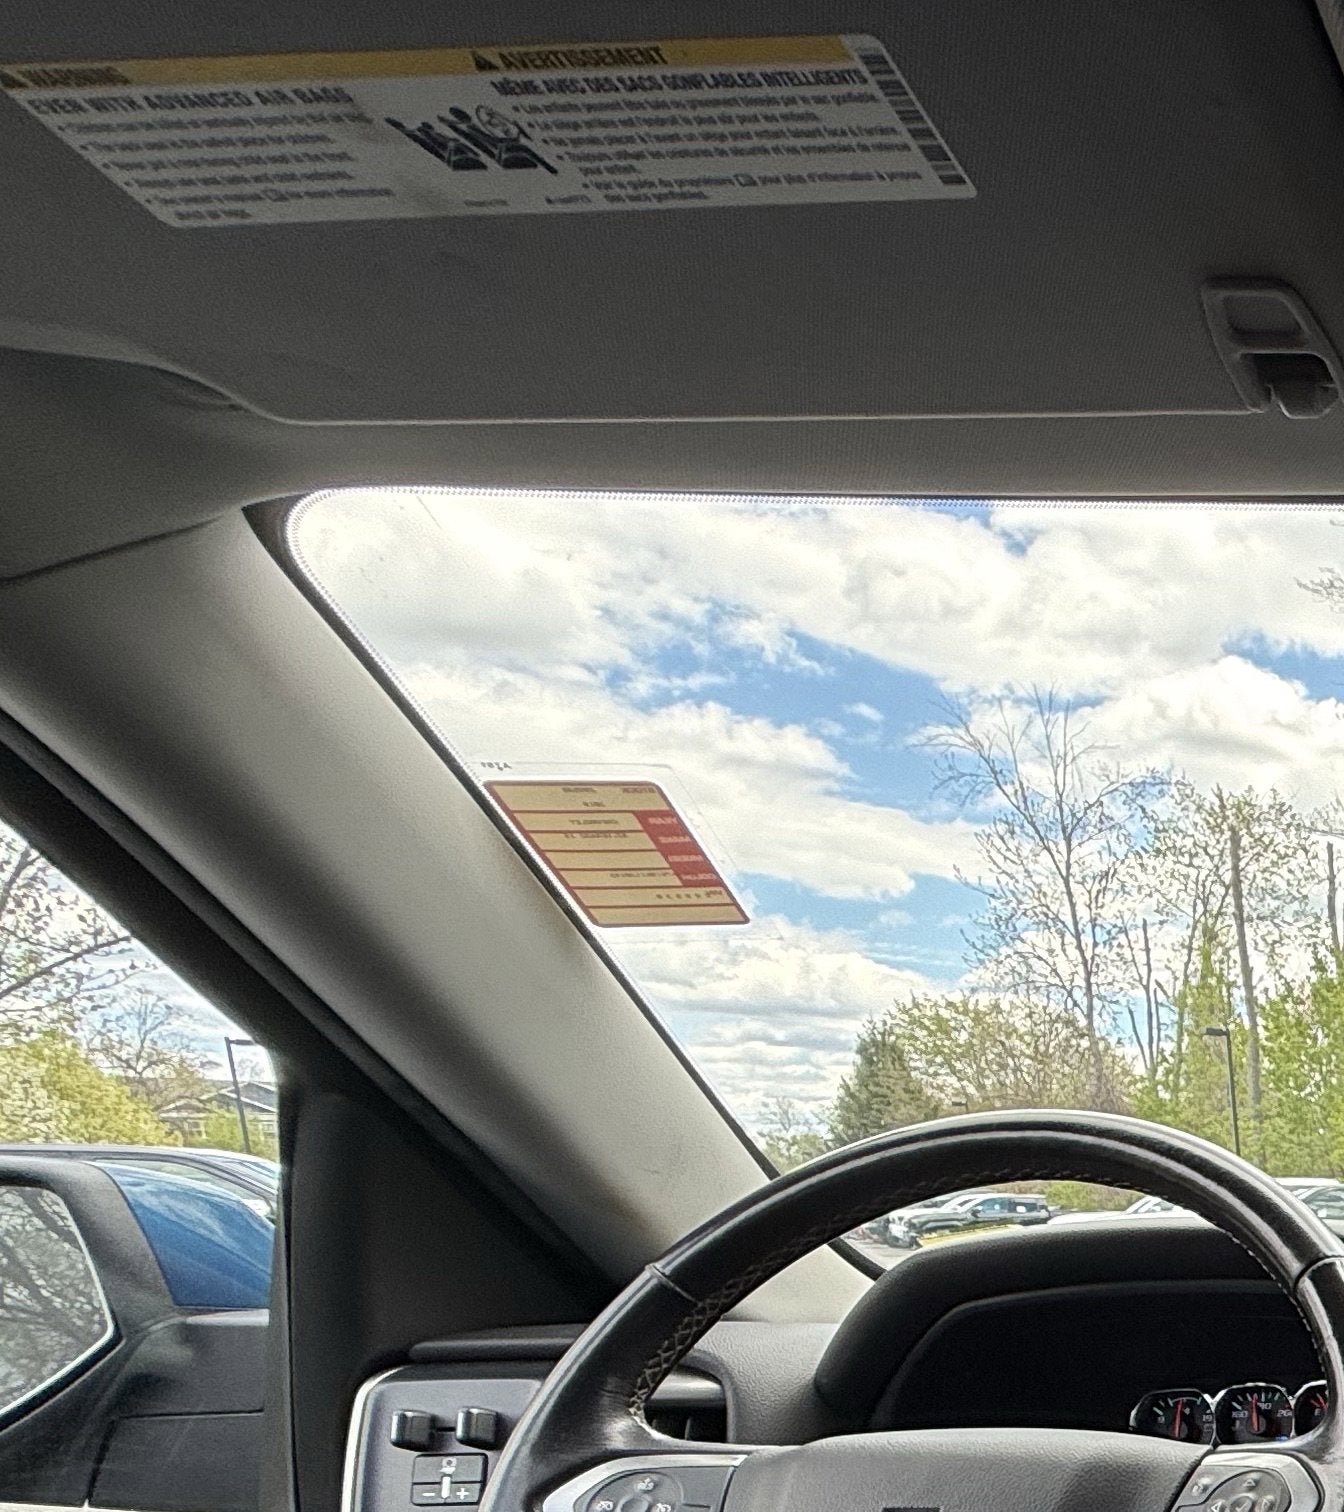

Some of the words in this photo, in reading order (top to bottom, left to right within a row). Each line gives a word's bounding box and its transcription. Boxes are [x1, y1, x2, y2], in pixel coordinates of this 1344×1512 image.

[499, 45, 668, 70] AVERTISSEMENT
[617, 74, 663, 92] SACS
[661, 71, 762, 91] GONFLABLES
[143, 91, 255, 111] ADVANCED
[254, 89, 295, 106] AIR
